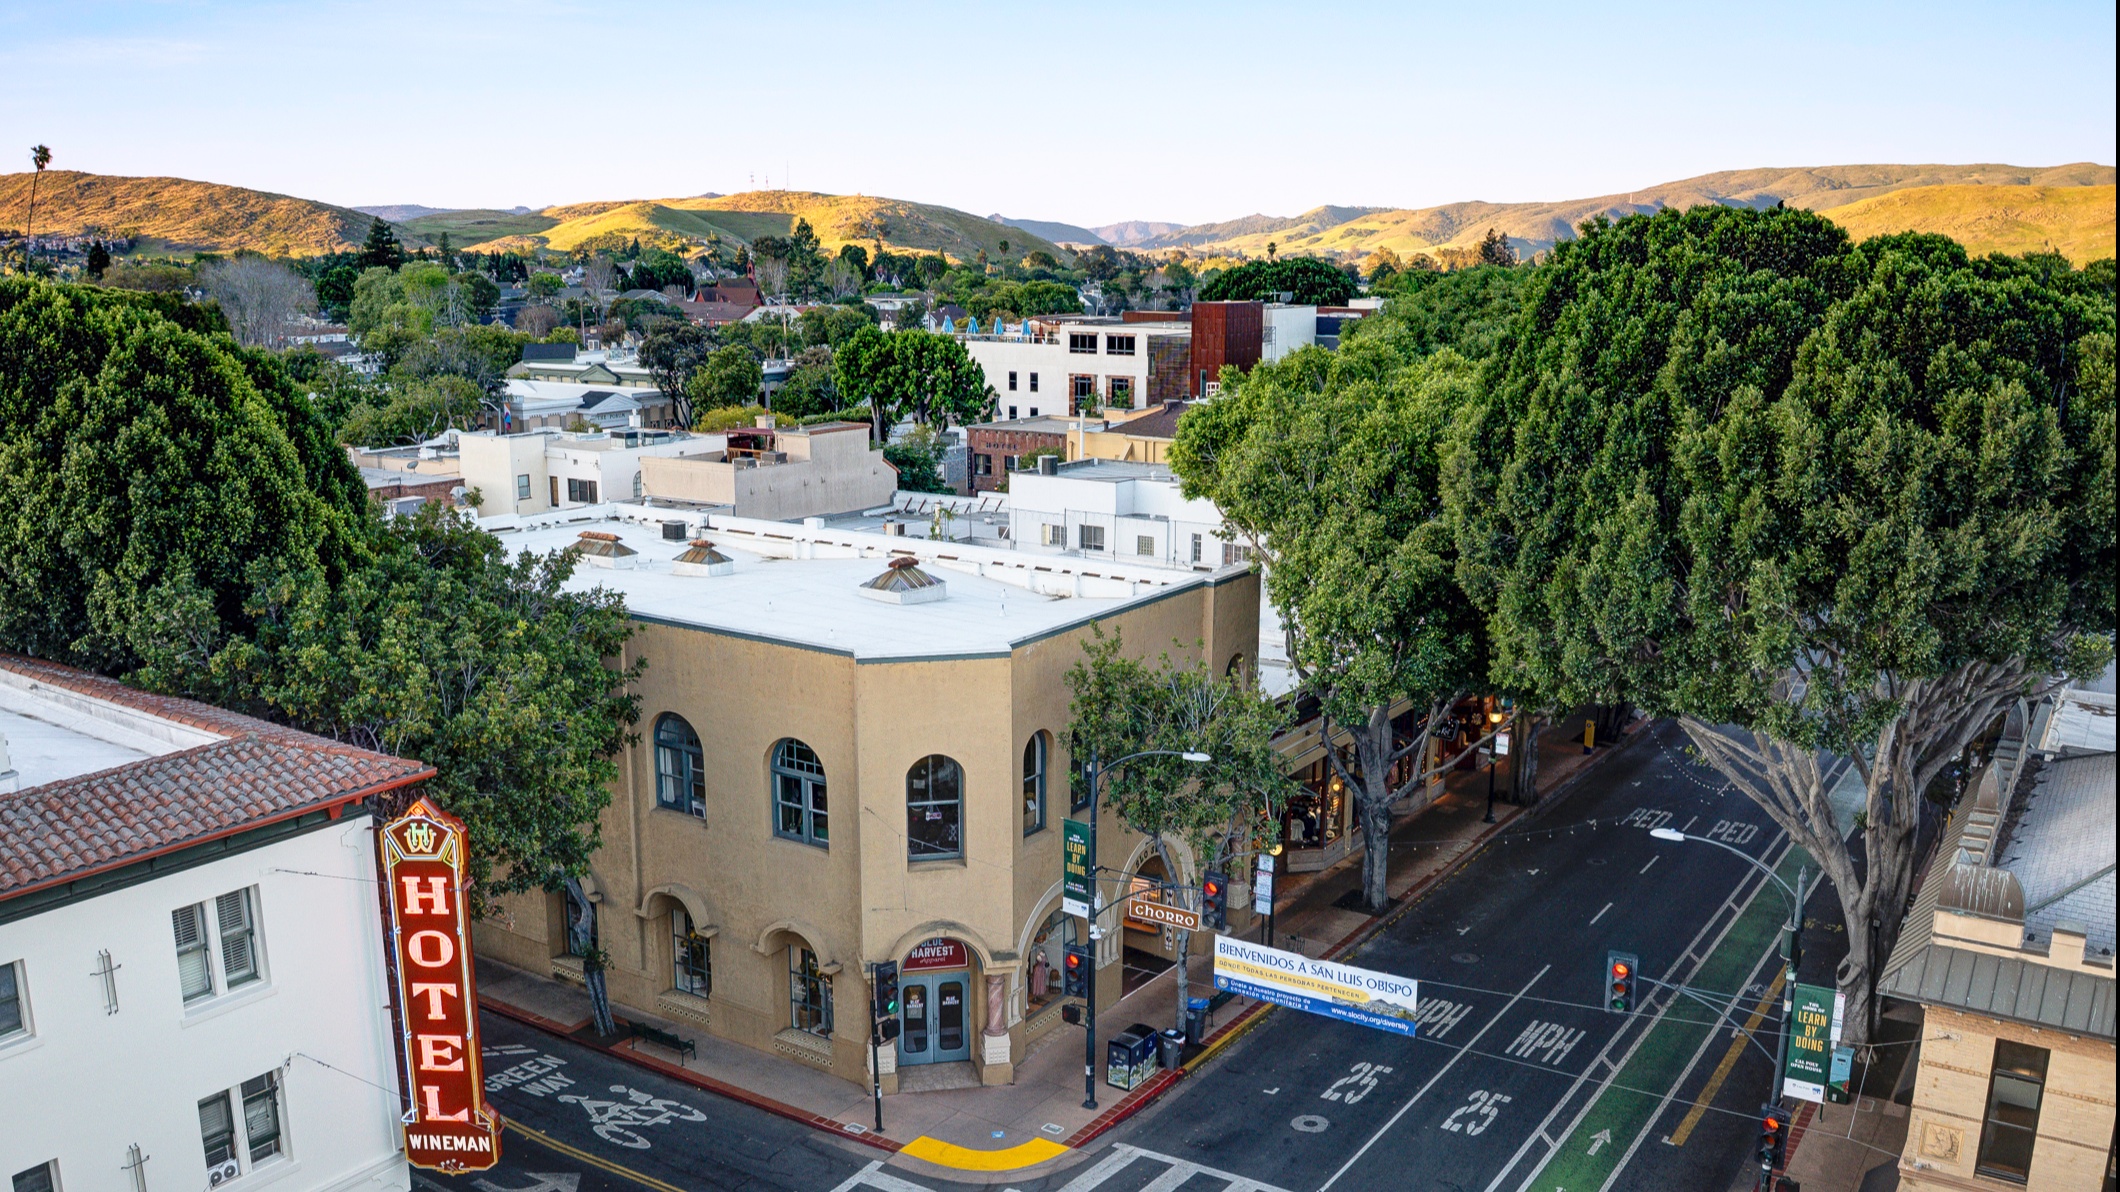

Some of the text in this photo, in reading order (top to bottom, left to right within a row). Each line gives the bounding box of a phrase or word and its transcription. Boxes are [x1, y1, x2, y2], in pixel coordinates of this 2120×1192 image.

[1621, 807, 1674, 829] PED
[1706, 819, 1759, 844] PED
[1066, 841, 1086, 855] LEARN
[1072, 854, 1080, 864] BY
[1067, 863, 1086, 876] DOING
[911, 945, 954, 958] HARVEST
[1219, 943, 1413, 997] BIENVENIDOS A SAN LUIS OBISPO
[1243, 966, 1263, 975] TODAS
[1280, 976, 1315, 987] PERSONAS
[1317, 984, 1360, 999] PERTENECEN
[401, 875, 469, 1121] HOTEL
[1261, 994, 1302, 1008] comunitaria
[1276, 991, 1302, 1002] proyecto
[1331, 1007, 1409, 1031] www.slocity.org/diversity
[1797, 1010, 1827, 1027] LEARN
[1805, 1024, 1817, 1038] BY
[1504, 1020, 1586, 1065] MPH
[1795, 1035, 1823, 1052] DOING
[484, 1054, 568, 1092] GREEN
[519, 1071, 576, 1097] WAY
[1320, 1061, 1393, 1104] 25
[1440, 1089, 1512, 1136] 25
[408, 1134, 491, 1152] WINEMAN
